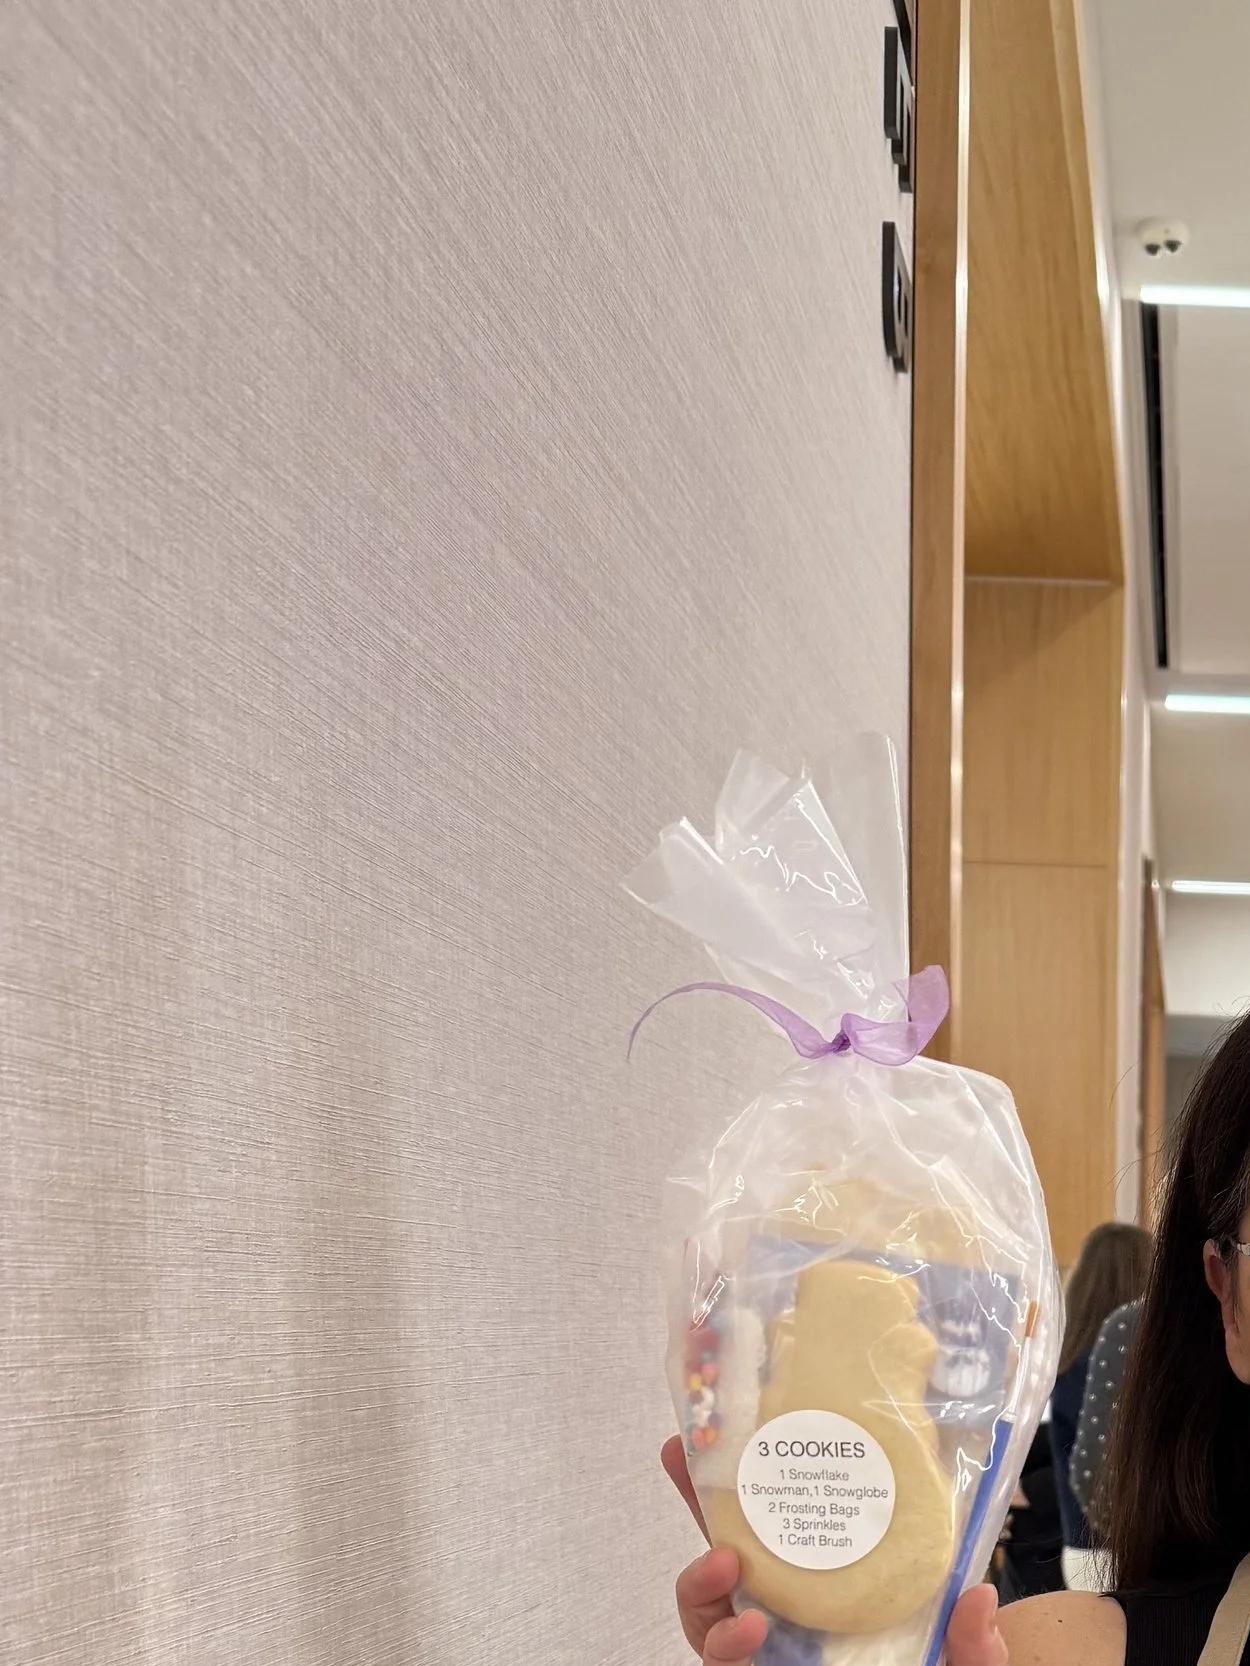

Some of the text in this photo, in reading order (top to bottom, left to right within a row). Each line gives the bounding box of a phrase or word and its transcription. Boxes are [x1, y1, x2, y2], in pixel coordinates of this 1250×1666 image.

[758, 1440, 866, 1459] 3 COOKIES
[780, 1468, 850, 1481] 1 Snowflake
[741, 1484, 747, 1495] 1
[823, 1485, 889, 1500] Snowglobe
[768, 1502, 860, 1518] 2 Frosting Bags
[783, 1518, 847, 1532] 3 Sprinkles
[779, 1533, 853, 1547] 1 Craft Brush
